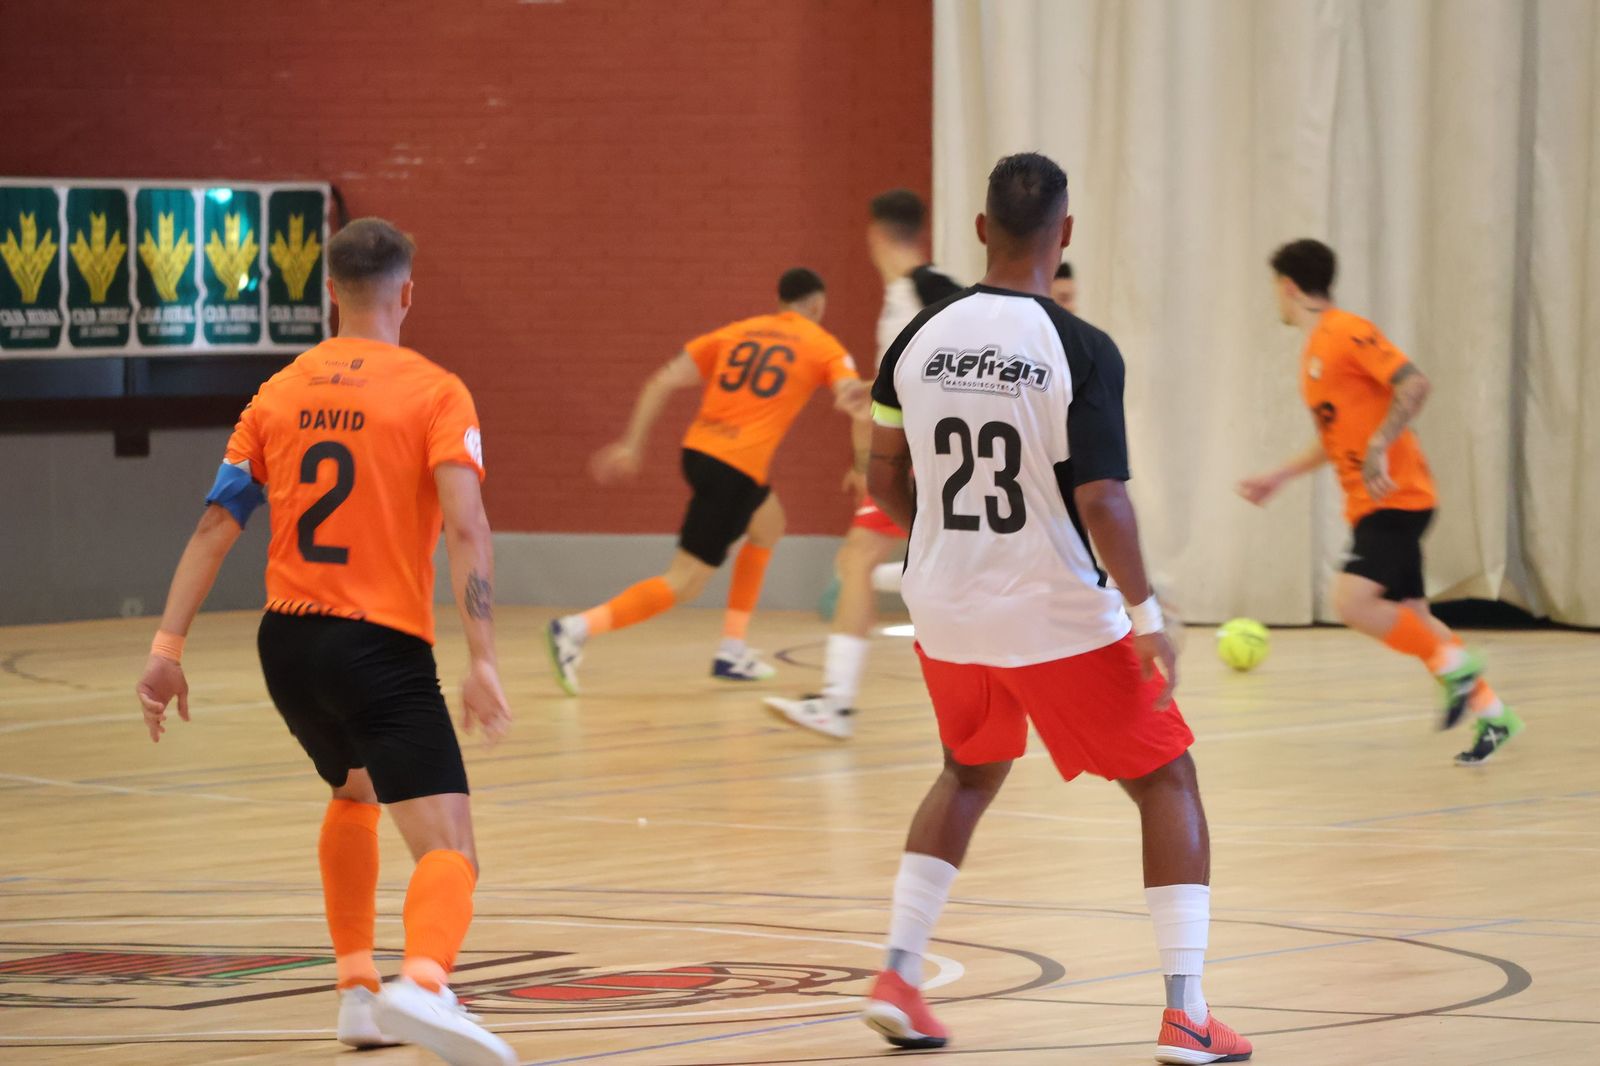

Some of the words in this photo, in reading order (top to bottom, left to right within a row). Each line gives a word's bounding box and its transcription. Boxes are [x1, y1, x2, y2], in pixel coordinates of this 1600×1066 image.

[719, 341, 796, 398] 96
[945, 380, 1015, 392] MACRODISCOTECA
[298, 409, 366, 432] DAVID
[297, 440, 355, 565] 2
[934, 416, 1027, 534] 23
